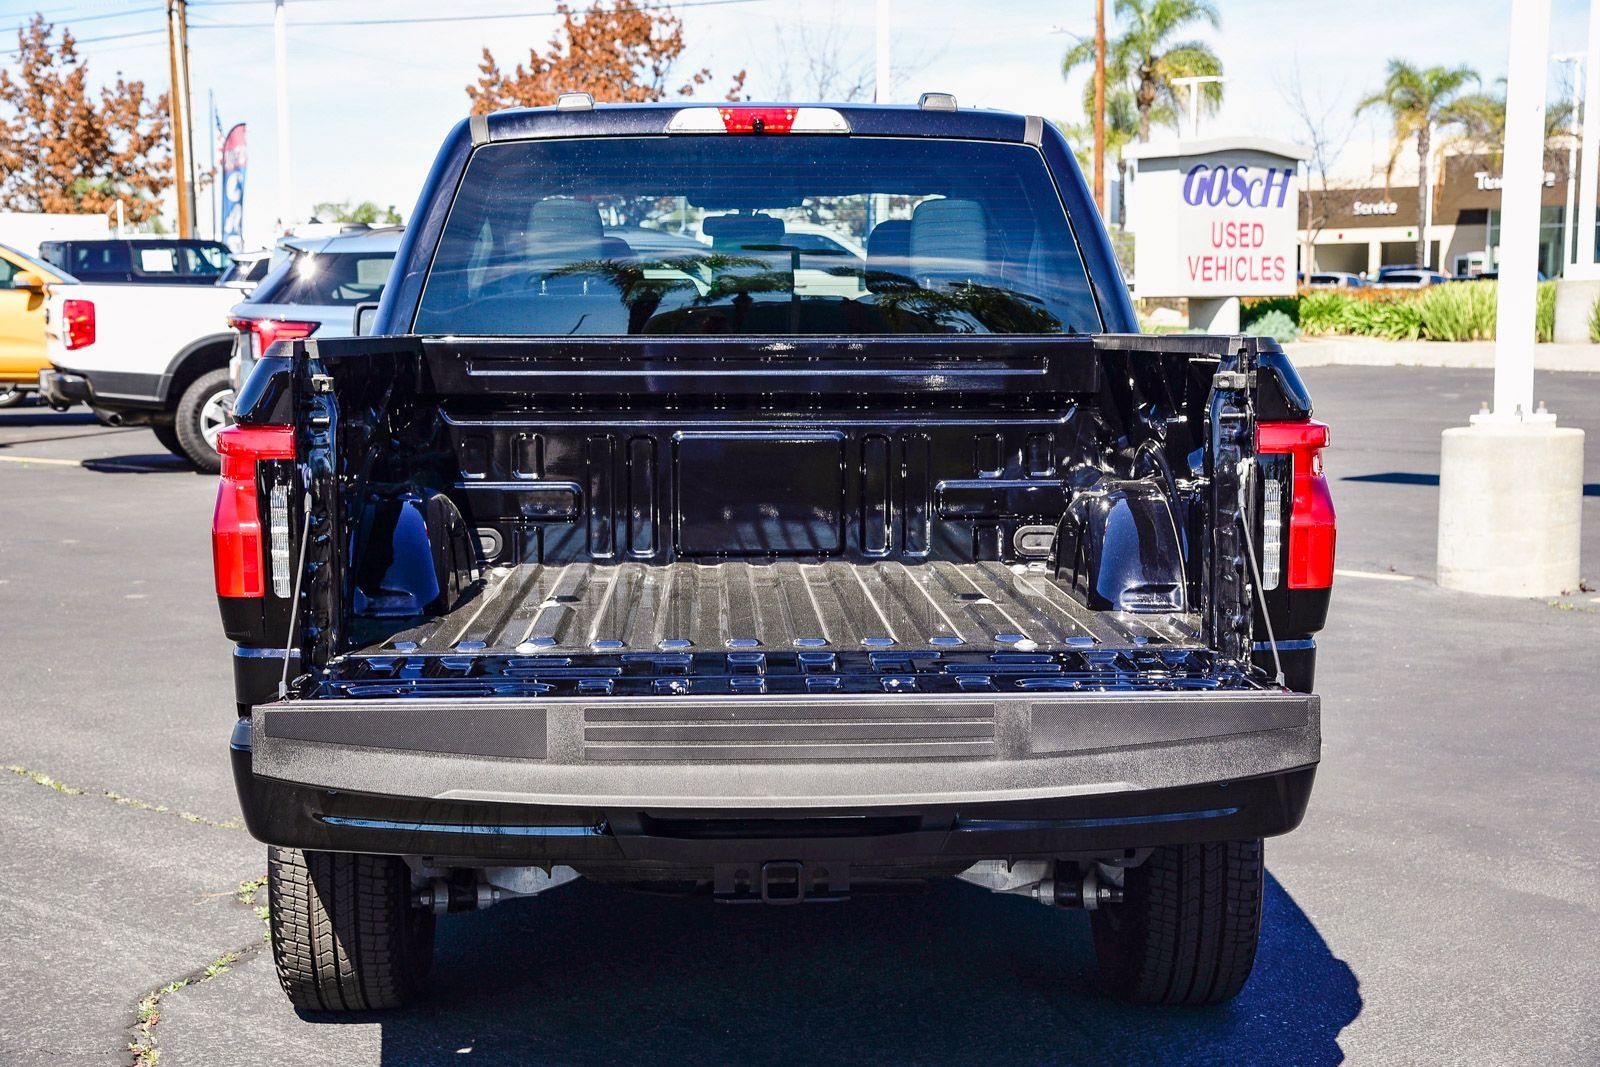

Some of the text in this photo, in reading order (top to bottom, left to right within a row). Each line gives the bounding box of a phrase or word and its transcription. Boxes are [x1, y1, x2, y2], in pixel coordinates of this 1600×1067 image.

[1353, 200, 1398, 215] Service
[1211, 222, 1265, 249] USED
[1188, 255, 1285, 281] VEHICLES
